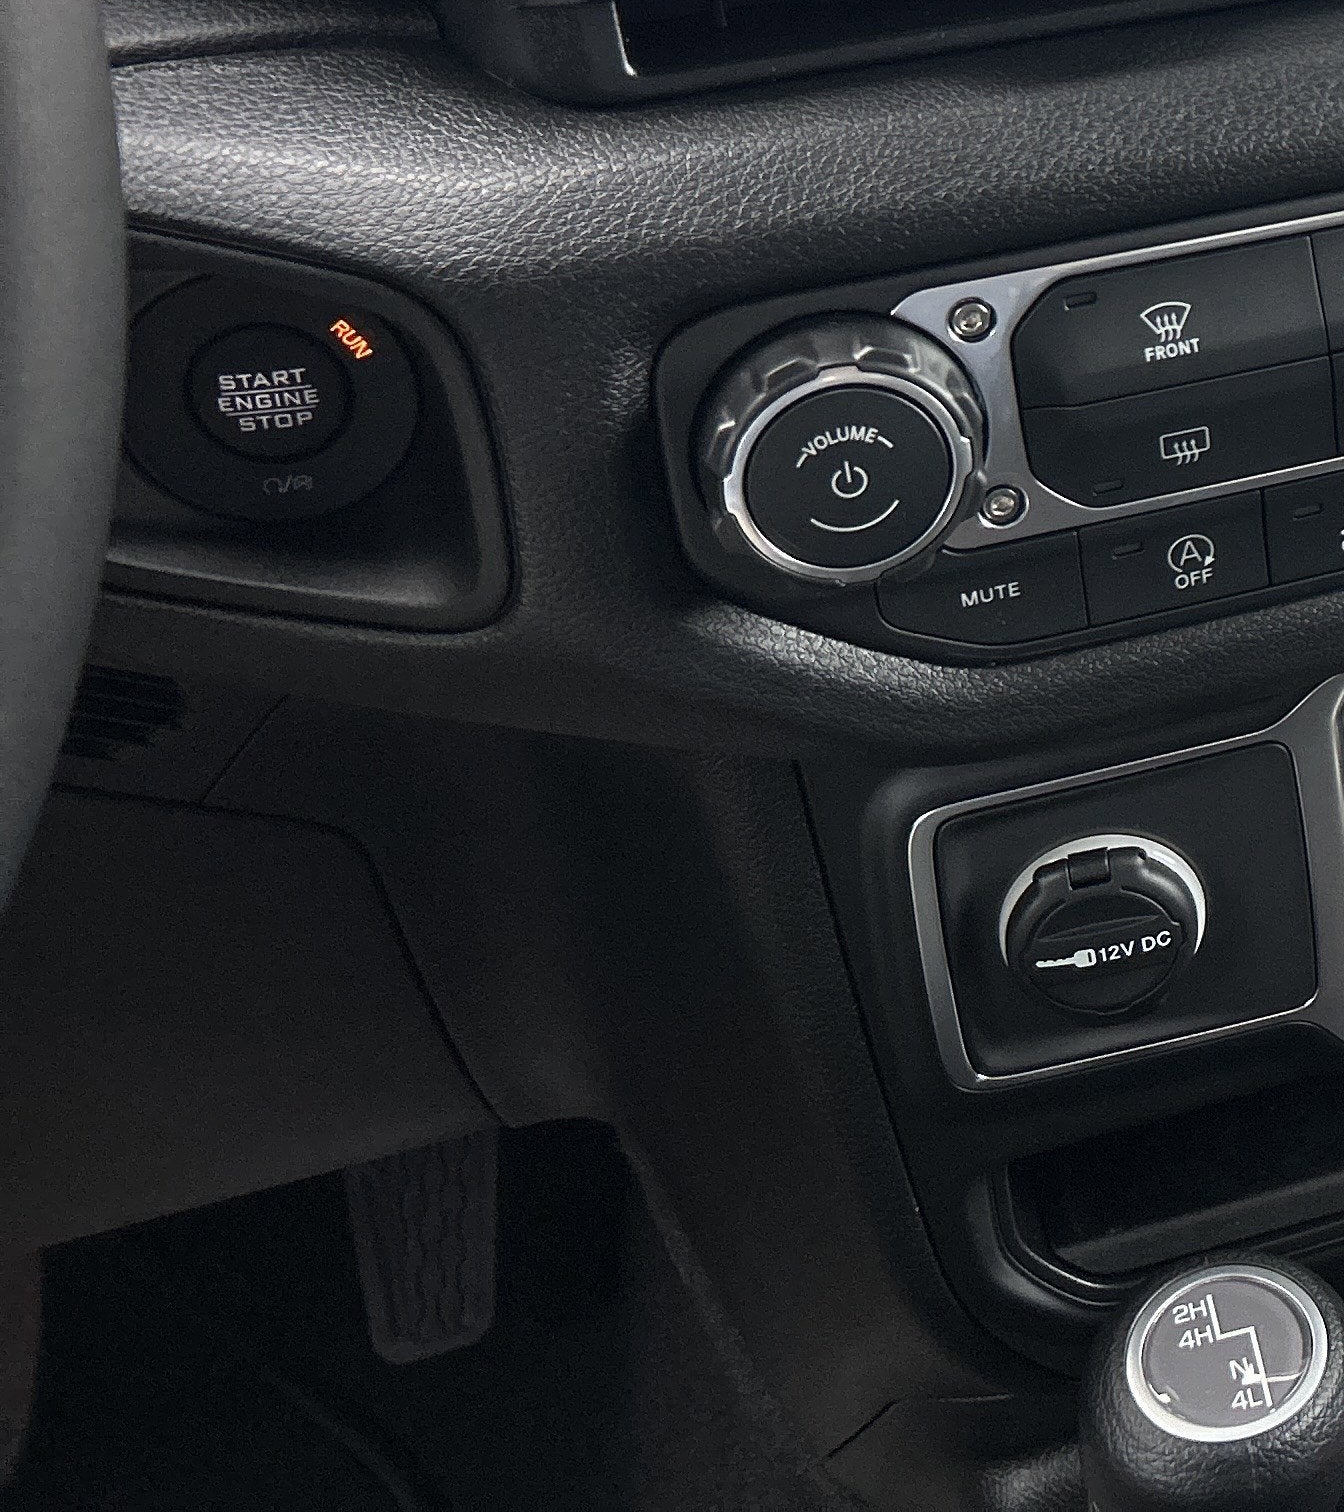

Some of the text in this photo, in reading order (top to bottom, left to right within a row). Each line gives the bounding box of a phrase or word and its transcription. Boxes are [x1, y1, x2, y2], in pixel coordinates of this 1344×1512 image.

[330, 319, 374, 360] RUN
[1143, 336, 1201, 363] FRONT
[219, 367, 307, 391] START
[217, 387, 320, 414] ENGINE
[238, 411, 314, 433] STOP
[804, 426, 880, 459] VOLUME
[1173, 565, 1214, 590] OFF
[959, 581, 1022, 608] MUTE
[1096, 930, 1173, 967] 12V DC
[1171, 1299, 1208, 1325] 2H
[1178, 1324, 1214, 1350] 4H
[1229, 1356, 1252, 1381] N
[1231, 1387, 1264, 1410] 4L
